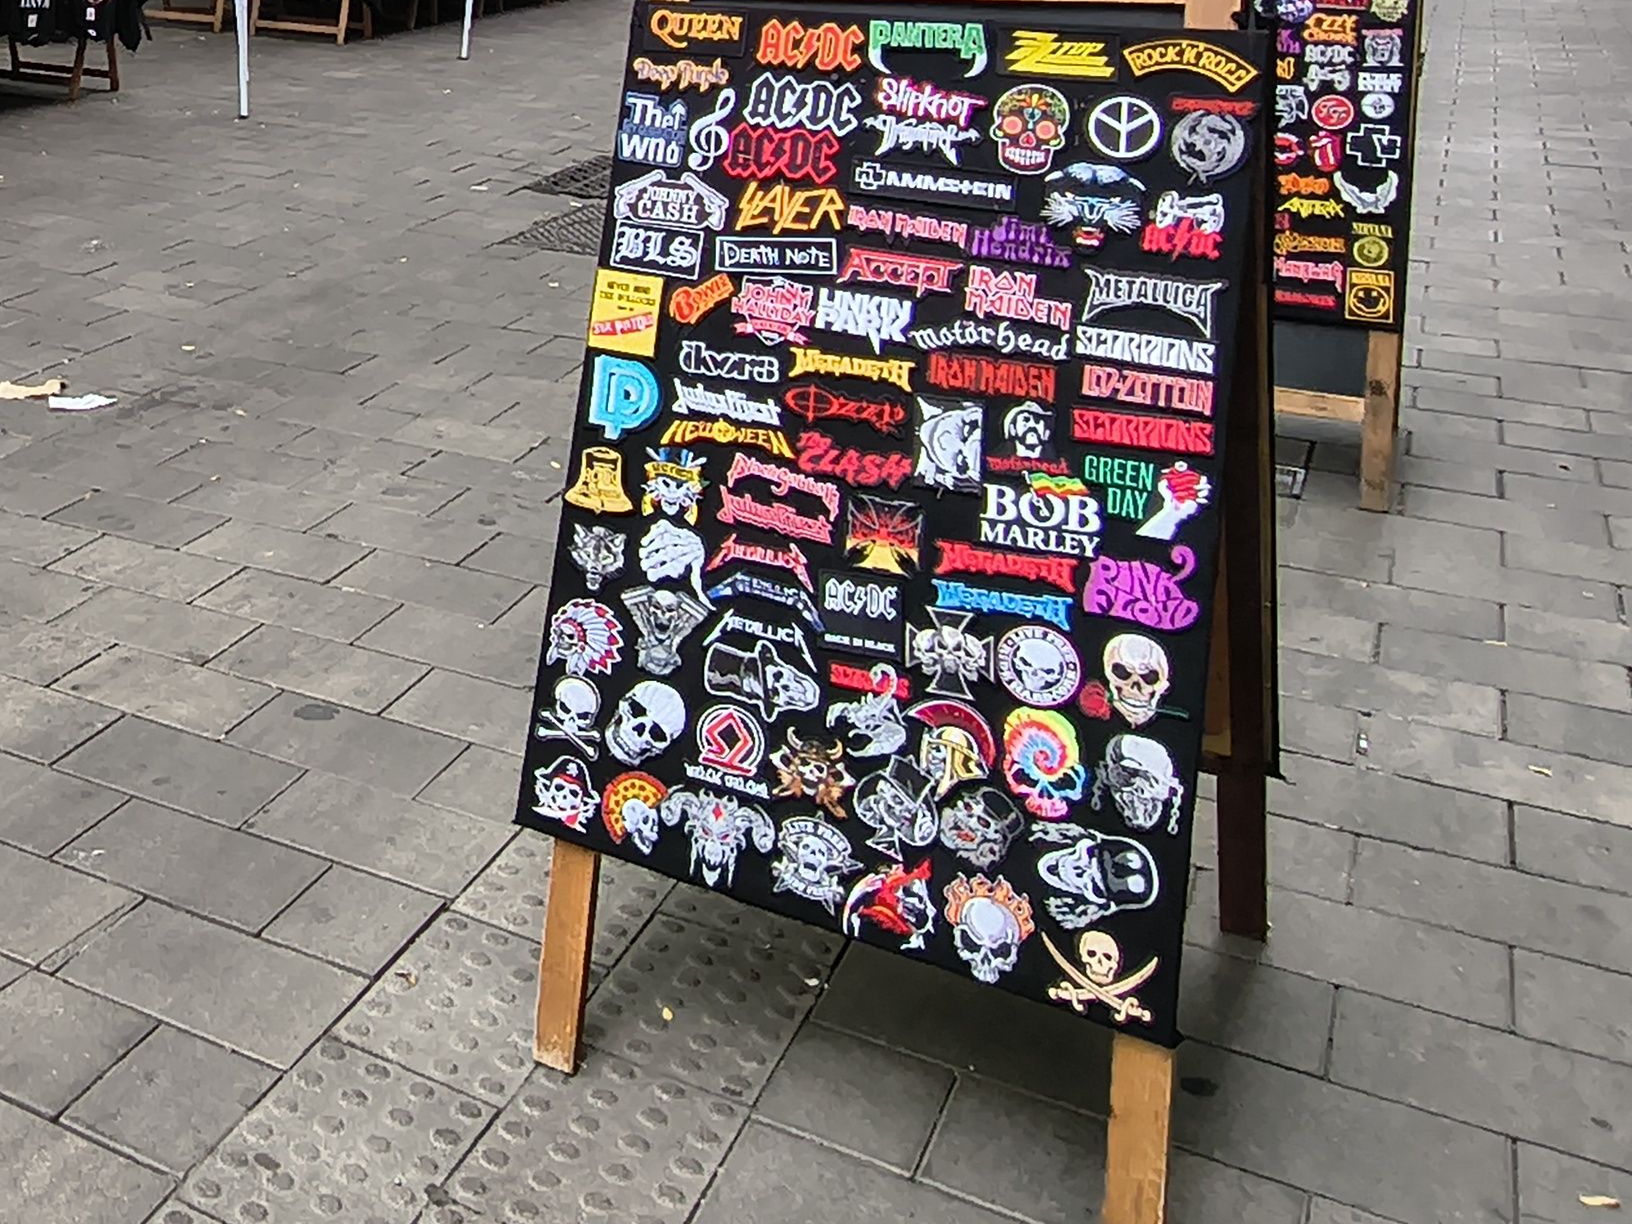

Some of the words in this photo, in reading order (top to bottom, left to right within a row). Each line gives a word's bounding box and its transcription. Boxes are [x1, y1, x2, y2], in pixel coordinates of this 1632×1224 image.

[651, 9, 744, 49] QUEEN
[756, 18, 865, 72] AC/DC
[868, 20, 988, 78] PANTERA
[626, 96, 675, 130] The
[742, 72, 862, 138] AC/DC
[722, 123, 841, 183] AC/DC
[636, 202, 700, 224] CASH
[642, 184, 697, 207] JOHNNY
[735, 181, 845, 236] SLAYER
[617, 228, 699, 270] BLS
[847, 204, 895, 237] IRON
[895, 211, 968, 250] MAIDEN
[972, 229, 1073, 268] Hendrix
[1139, 216, 1223, 263] AC/DC
[723, 242, 779, 266] DEATH
[836, 247, 965, 298] ACCEPT
[740, 282, 813, 308] JOHNNY
[819, 287, 916, 319] LINKIN
[970, 265, 1038, 300] IRON
[1082, 268, 1222, 340] METALLICA
[731, 297, 816, 326] HALLYDAY
[815, 305, 915, 356] PARK
[964, 287, 1073, 331] MAIDEN
[789, 346, 918, 393] MEGADETH
[1075, 325, 1216, 375] SCORPIONS
[929, 353, 977, 389] IRON
[979, 359, 1057, 403] MAIDEN
[660, 418, 797, 460] HELLOWEEN
[1072, 408, 1216, 455] SCORPIONS
[798, 445, 914, 490] CLASH
[1084, 454, 1155, 492] GREEN
[979, 482, 1102, 534] BOB
[1106, 487, 1149, 520] DAY
[979, 519, 1102, 559] MARLEY
[934, 539, 1080, 594] MEGADETH
[1088, 543, 1197, 606] PINK
[824, 577, 899, 621] AC/DC
[930, 578, 1074, 632] MEGADETH
[1082, 582, 1201, 631] FLOYD
[702, 607, 818, 673] METALLICA
